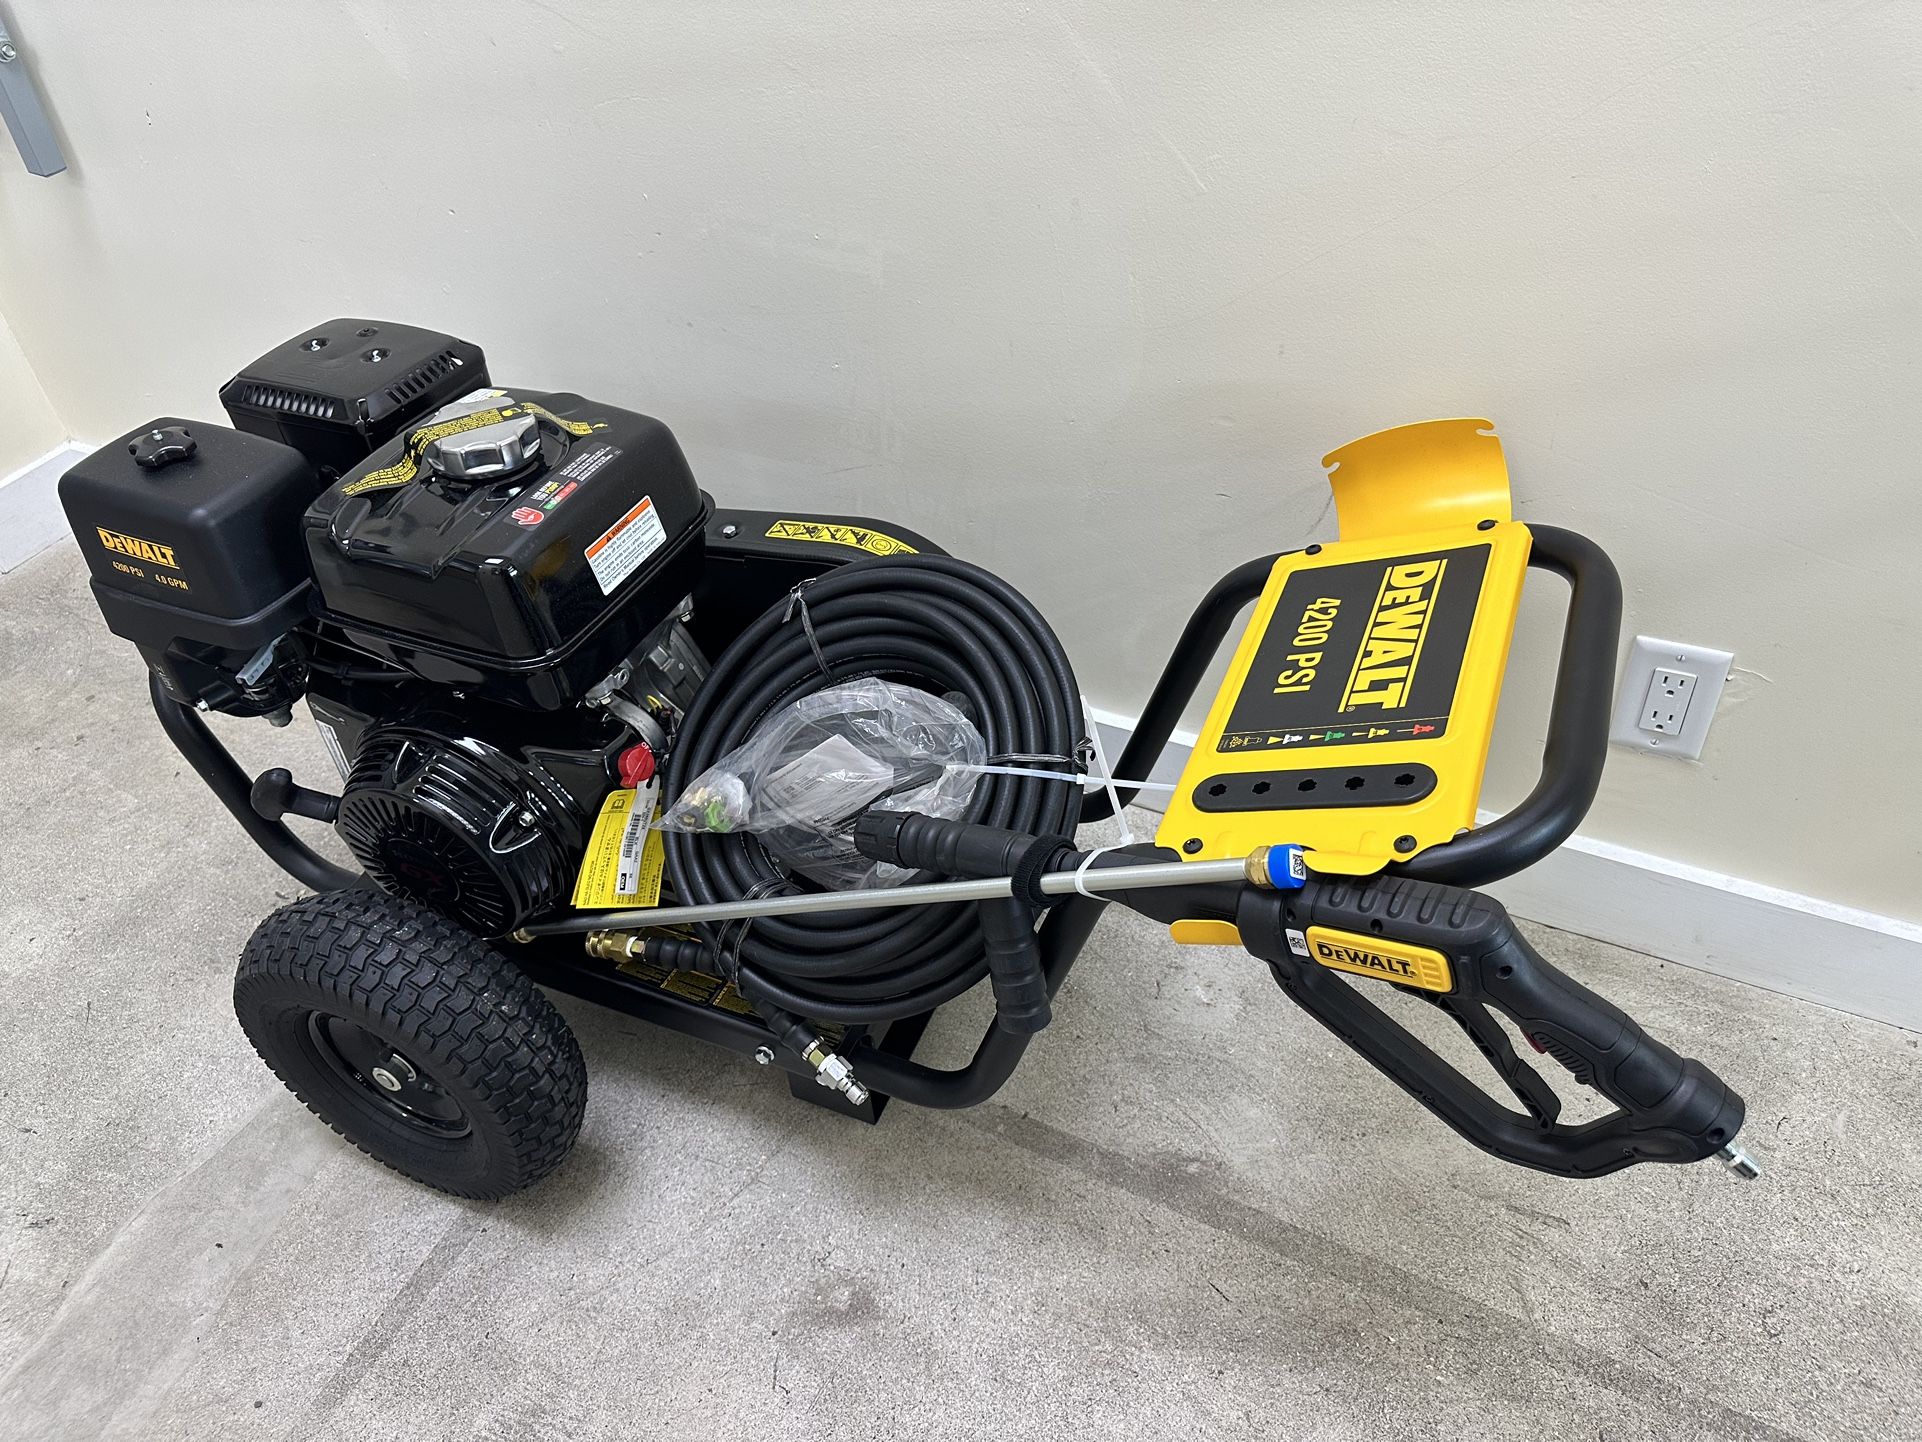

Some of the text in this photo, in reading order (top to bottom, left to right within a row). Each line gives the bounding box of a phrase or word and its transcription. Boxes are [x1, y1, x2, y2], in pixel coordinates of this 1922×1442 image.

[612, 518, 630, 537] WARNING
[97, 528, 177, 566] DEWALT
[112, 561, 145, 578] 4200 PSI
[155, 574, 189, 590] 4.0 GPM
[1273, 597, 1342, 694] 4200 PSI
